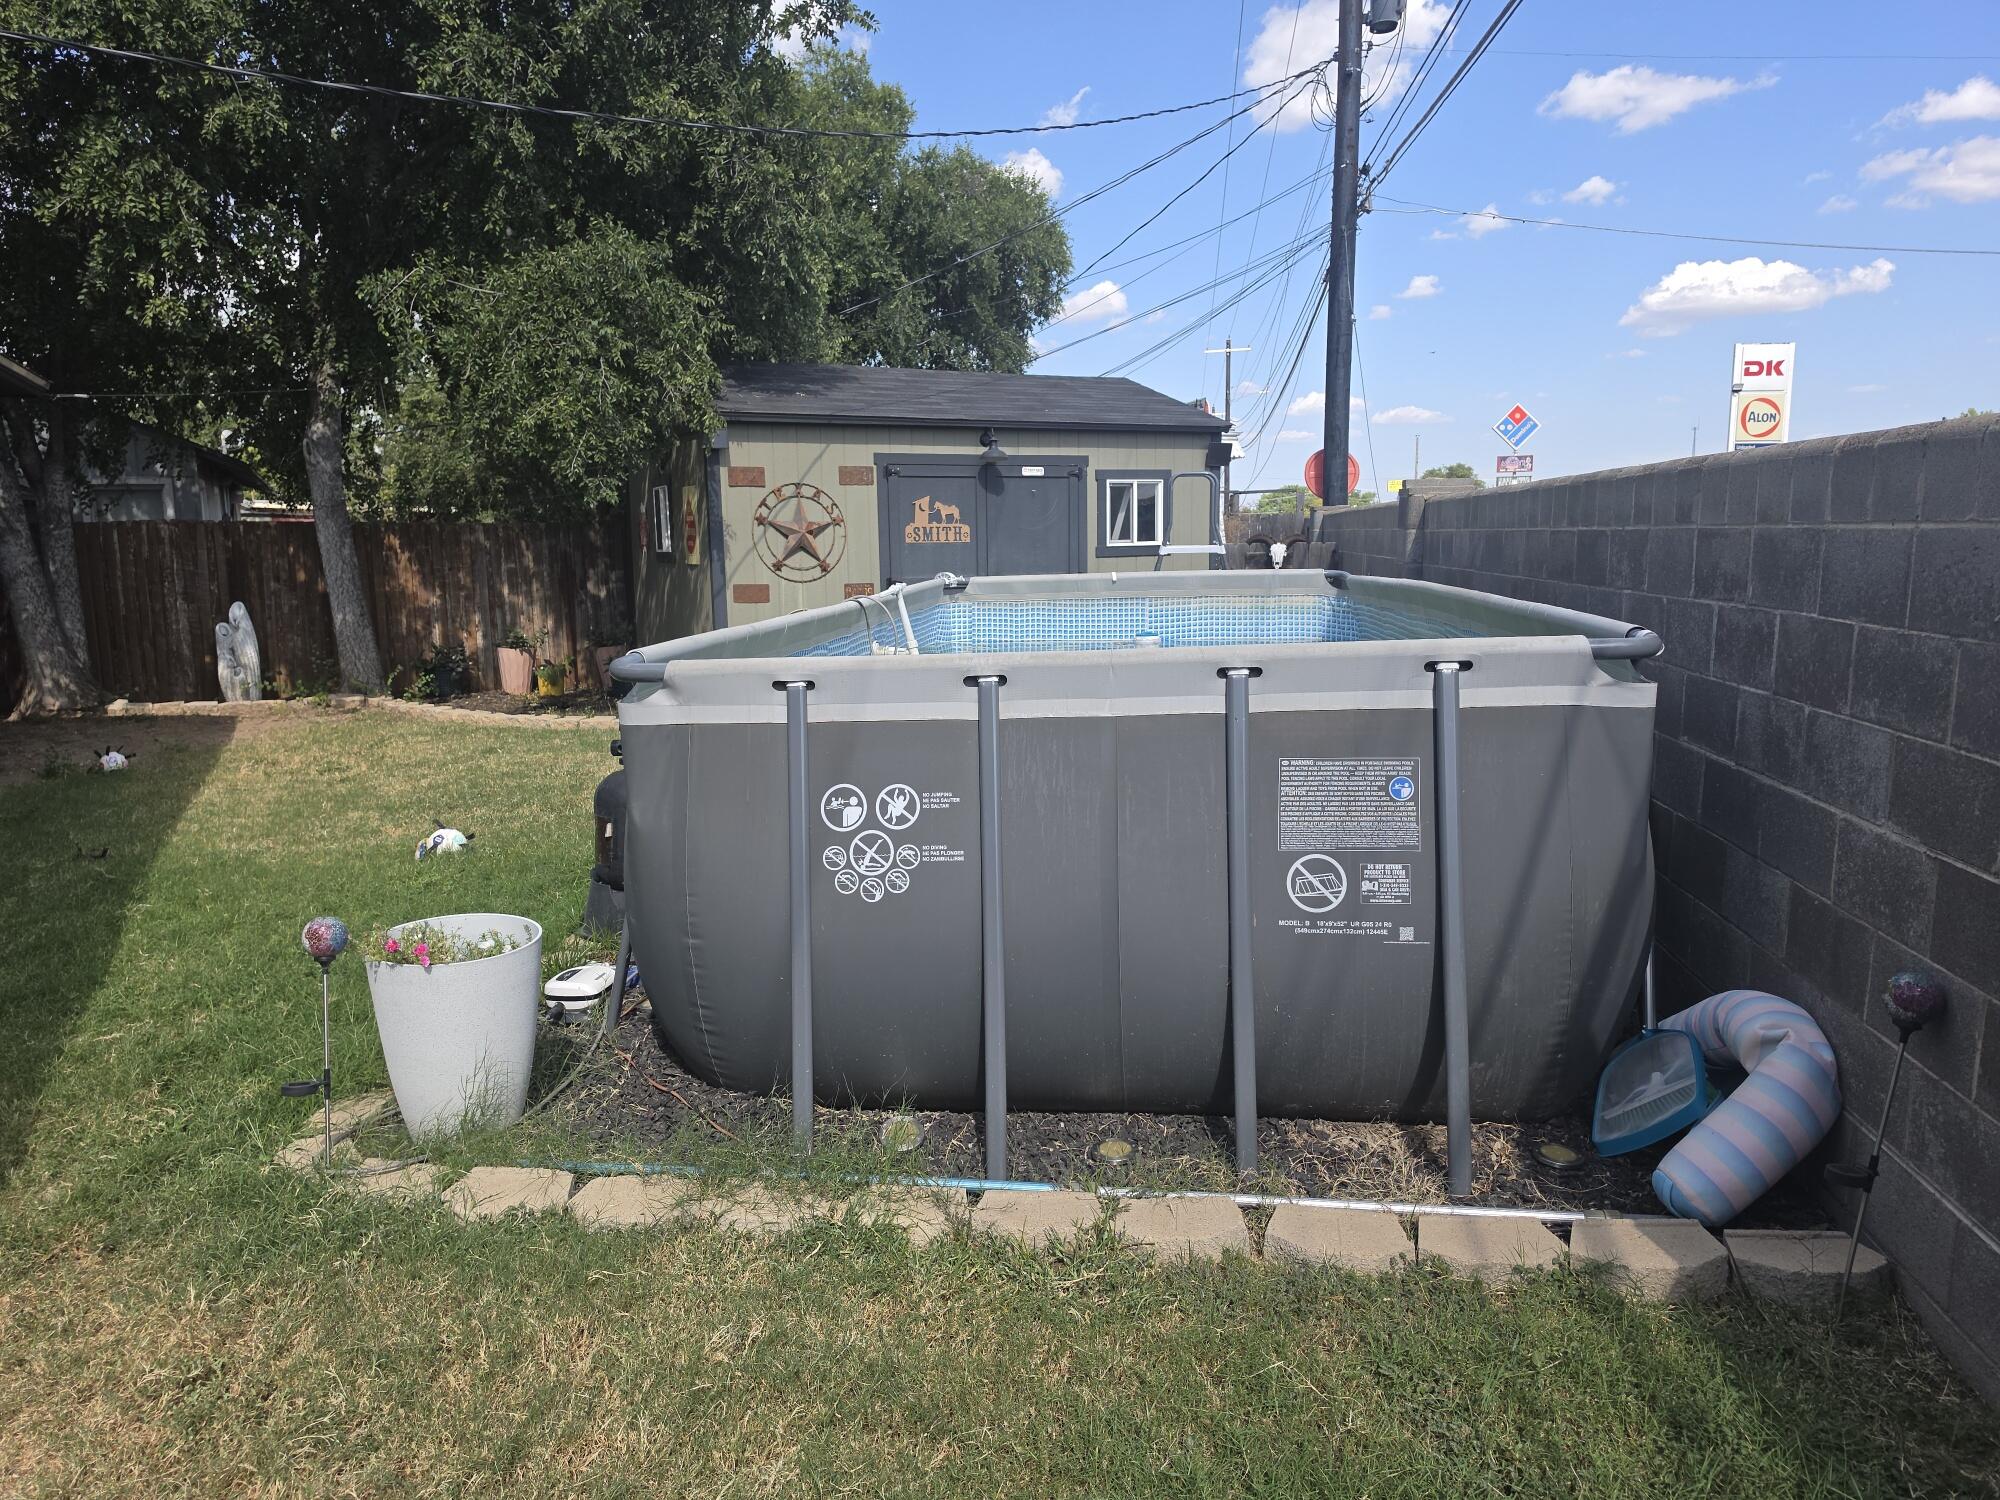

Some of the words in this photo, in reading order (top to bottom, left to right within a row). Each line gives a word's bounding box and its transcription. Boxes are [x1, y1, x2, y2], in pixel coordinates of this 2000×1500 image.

[1744, 360, 1785, 376] DK
[1748, 411, 1777, 422] ALON
[913, 527, 962, 542] SMITH
